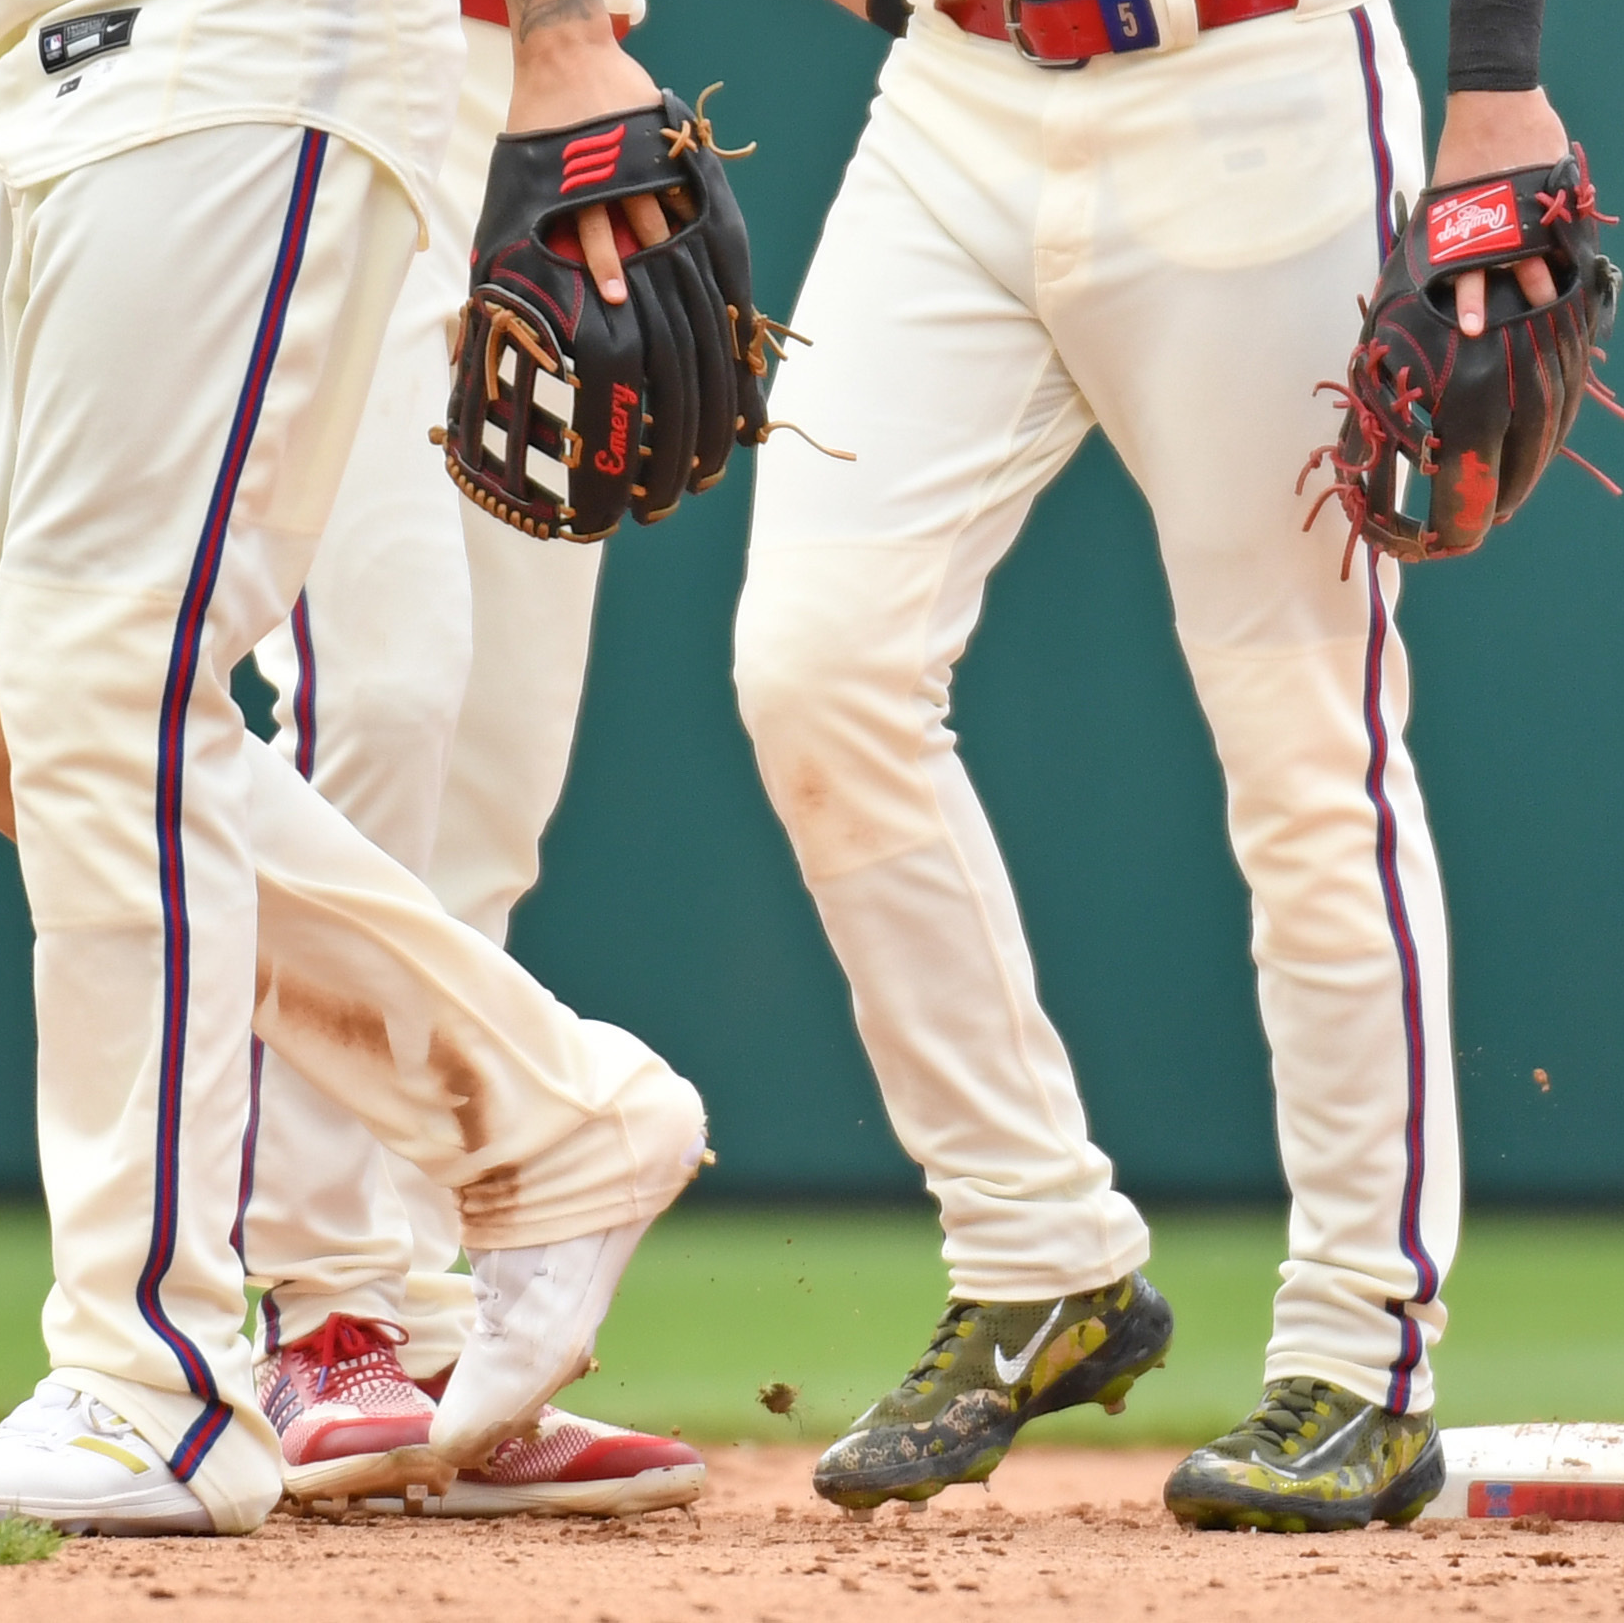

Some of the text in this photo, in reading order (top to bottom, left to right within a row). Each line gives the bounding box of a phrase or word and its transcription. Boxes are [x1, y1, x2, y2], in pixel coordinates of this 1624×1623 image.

[1117, 1, 1139, 38] 5
[1435, 202, 1508, 244] Rawlings
[594, 382, 639, 476] Emery
